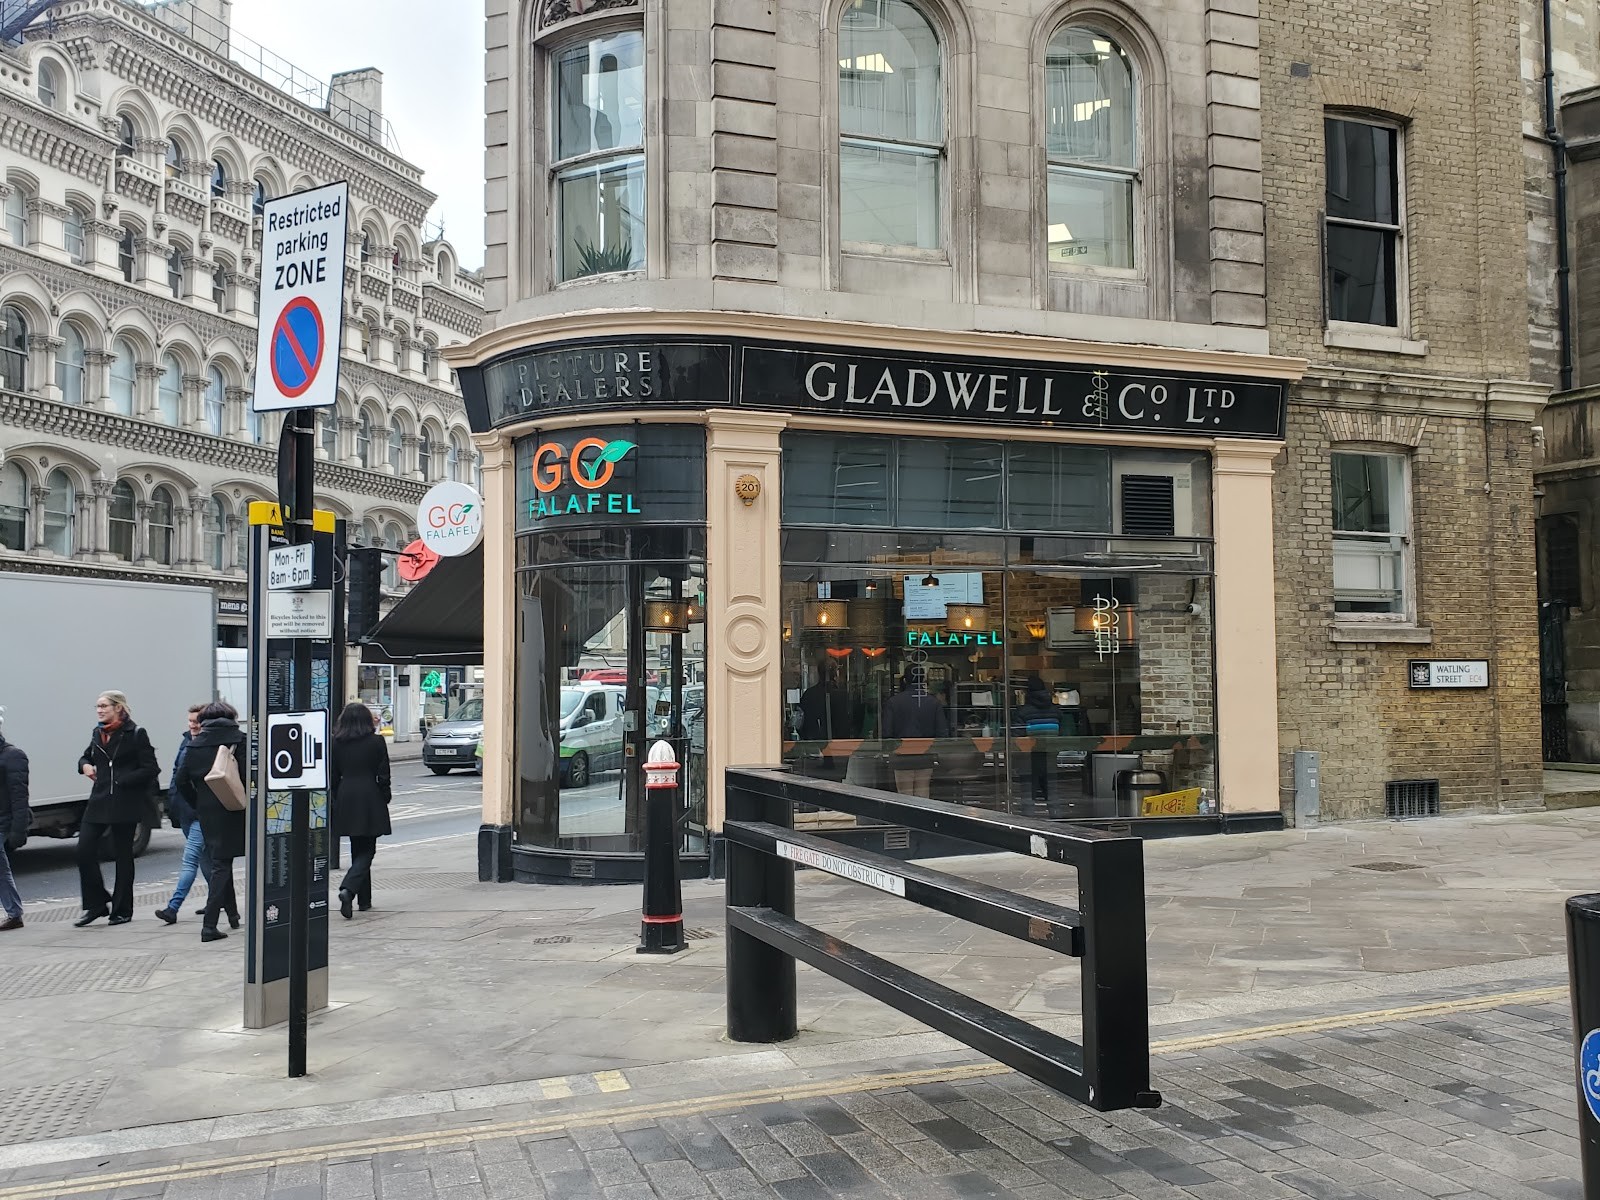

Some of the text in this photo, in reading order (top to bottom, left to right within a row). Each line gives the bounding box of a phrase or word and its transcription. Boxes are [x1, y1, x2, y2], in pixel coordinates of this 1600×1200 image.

[269, 196, 340, 232] Restricted
[276, 230, 328, 260] parking
[274, 257, 326, 290] ZONE
[518, 352, 652, 384] PICTURE
[520, 376, 653, 407] DEALERS
[805, 361, 1061, 415] GLADWELL
[532, 437, 614, 493] GO
[741, 483, 758, 492] 201
[428, 503, 466, 529] GO
[529, 494, 641, 519] FALAFEL
[426, 525, 477, 540] FALAFEL
[220, 601, 240, 611] mens
[908, 630, 1002, 646] FALAFEL
[1436, 665, 1470, 674] WATLING
[1436, 674, 1482, 684] STREET EC4
[790, 846, 886, 888] FIRE GATE DO NOT OBSTRUCT
